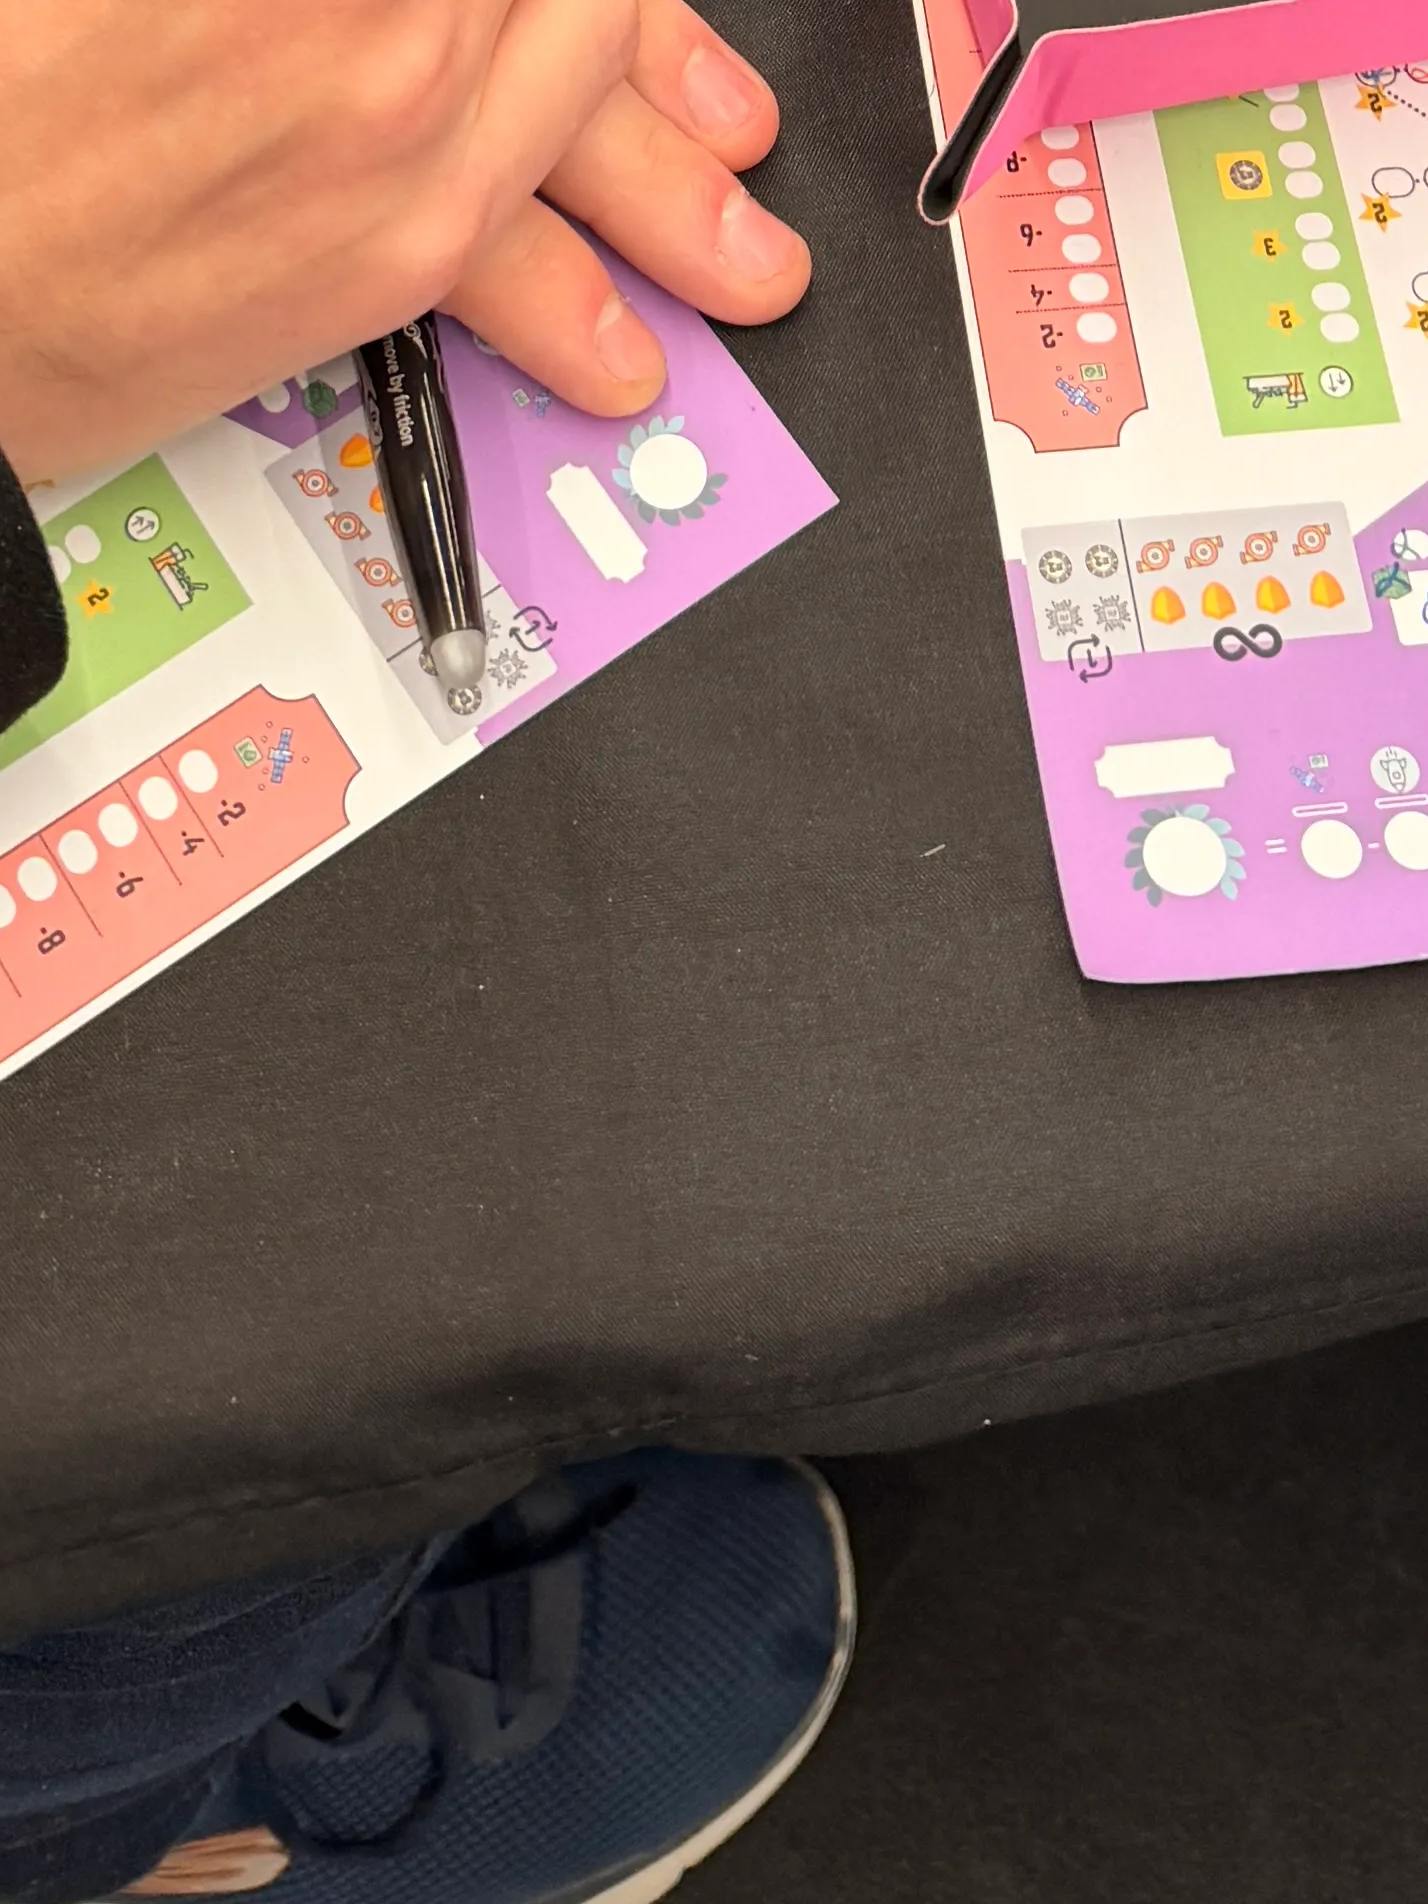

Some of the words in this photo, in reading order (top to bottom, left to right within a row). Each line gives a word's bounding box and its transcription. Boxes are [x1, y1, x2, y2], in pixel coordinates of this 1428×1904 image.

[1367, 90, 1384, 114] 2
[1369, 201, 1389, 223] 2
[1019, 222, 1044, 247] -6
[1263, 236, 1279, 258] 3
[1029, 283, 1054, 305] -4
[1279, 307, 1294, 330] 2
[1039, 323, 1064, 349] -2
[392, 393, 415, 447] friction
[86, 586, 110, 608] 2
[217, 798, 247, 826] -2
[180, 827, 206, 856] -4
[115, 870, 145, 899] -6
[37, 925, 67, 955] -8
